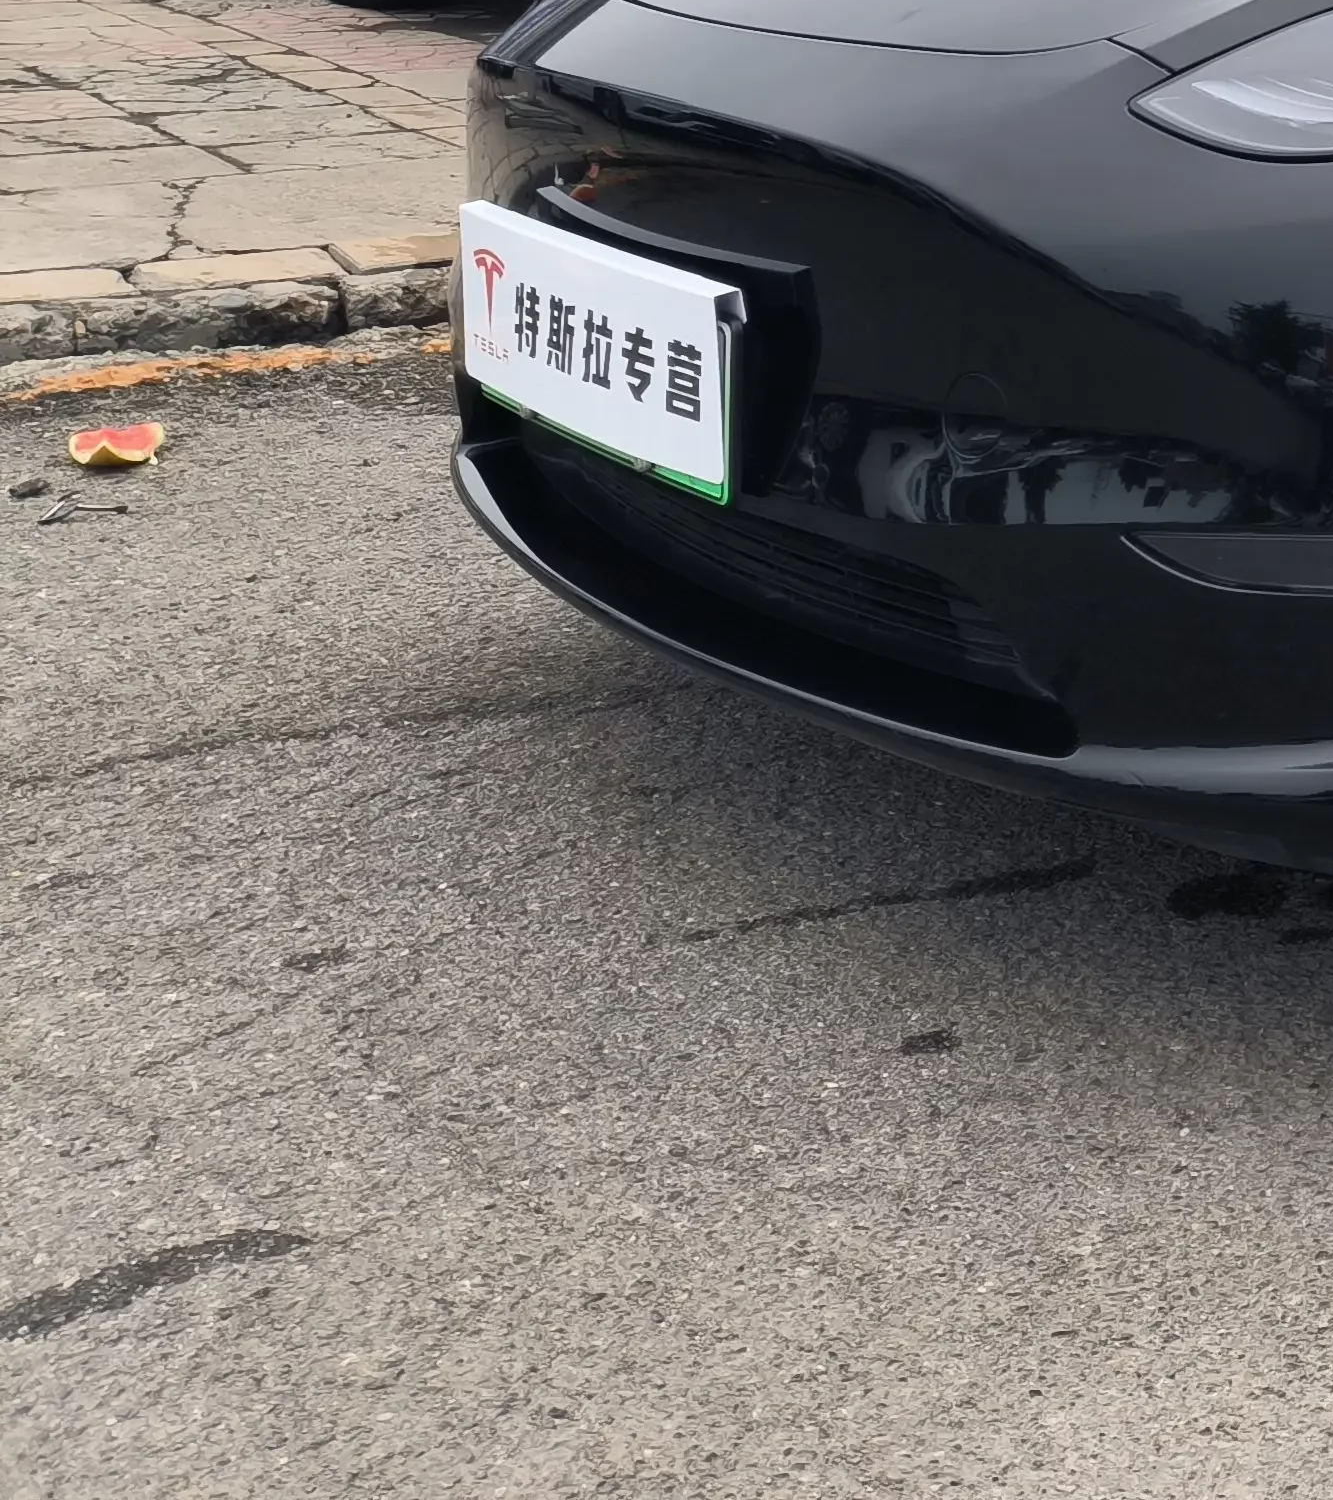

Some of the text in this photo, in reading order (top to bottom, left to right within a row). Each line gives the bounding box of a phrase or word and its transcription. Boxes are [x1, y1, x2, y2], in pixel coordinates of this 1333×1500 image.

[472, 332, 510, 366] TESLA
[514, 282, 702, 422] 特斯拉专营
